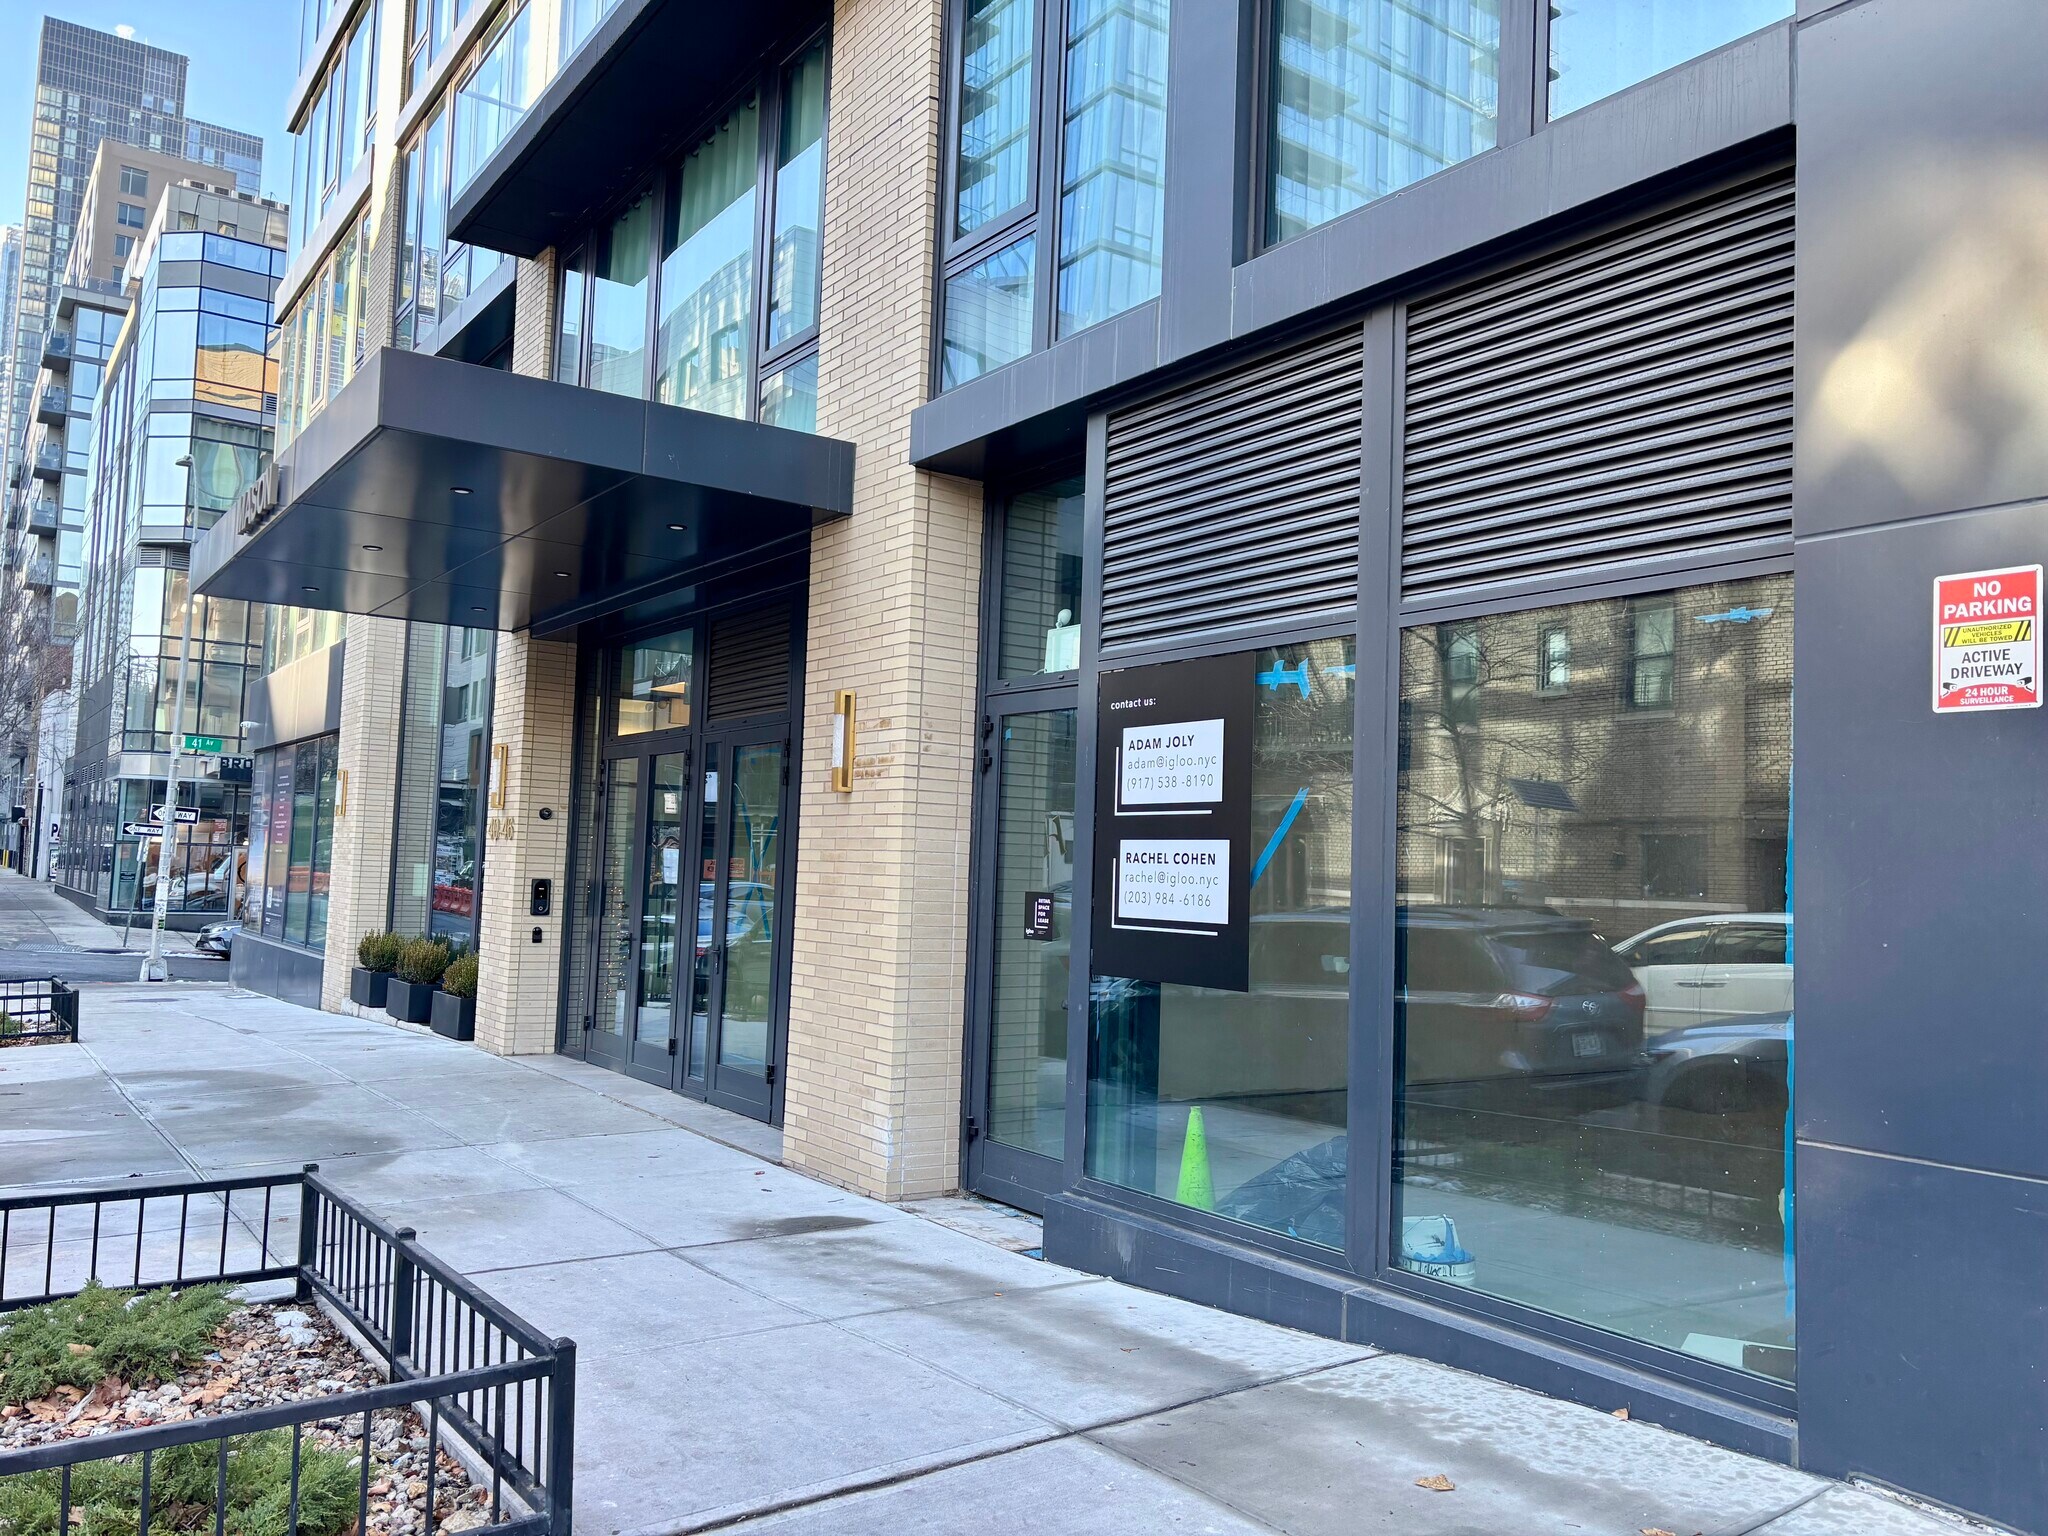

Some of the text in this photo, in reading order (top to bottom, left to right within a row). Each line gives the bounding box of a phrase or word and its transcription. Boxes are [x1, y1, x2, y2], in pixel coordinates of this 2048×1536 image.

[1973, 581, 2002, 597] NO
[1944, 596, 2032, 619] PARKING
[1962, 624, 2012, 633] UNAUTHORIZED
[1972, 630, 2002, 638] VEHICLES
[1962, 648, 2011, 664] ACTIVE
[1951, 662, 2023, 679] DRIVEWAY
[1965, 686, 2009, 697] 24 HOUR
[1110, 697, 1157, 710] contact us:
[1960, 695, 2015, 705] SURVEILLANCE
[191, 738, 202, 748] 41
[1128, 734, 1195, 751] ADAM JOLY
[1127, 754, 1217, 771] adam@igloo.nyc
[1126, 773, 1214, 791] (917) 538 -8190
[177, 811, 193, 819] WAY
[488, 817, 514, 841] 40-46
[1125, 852, 1216, 865] RACHEL COHEN
[1125, 870, 1219, 888] rachel@igloo.nyc
[1124, 890, 1211, 907] (203) 984 -6186
